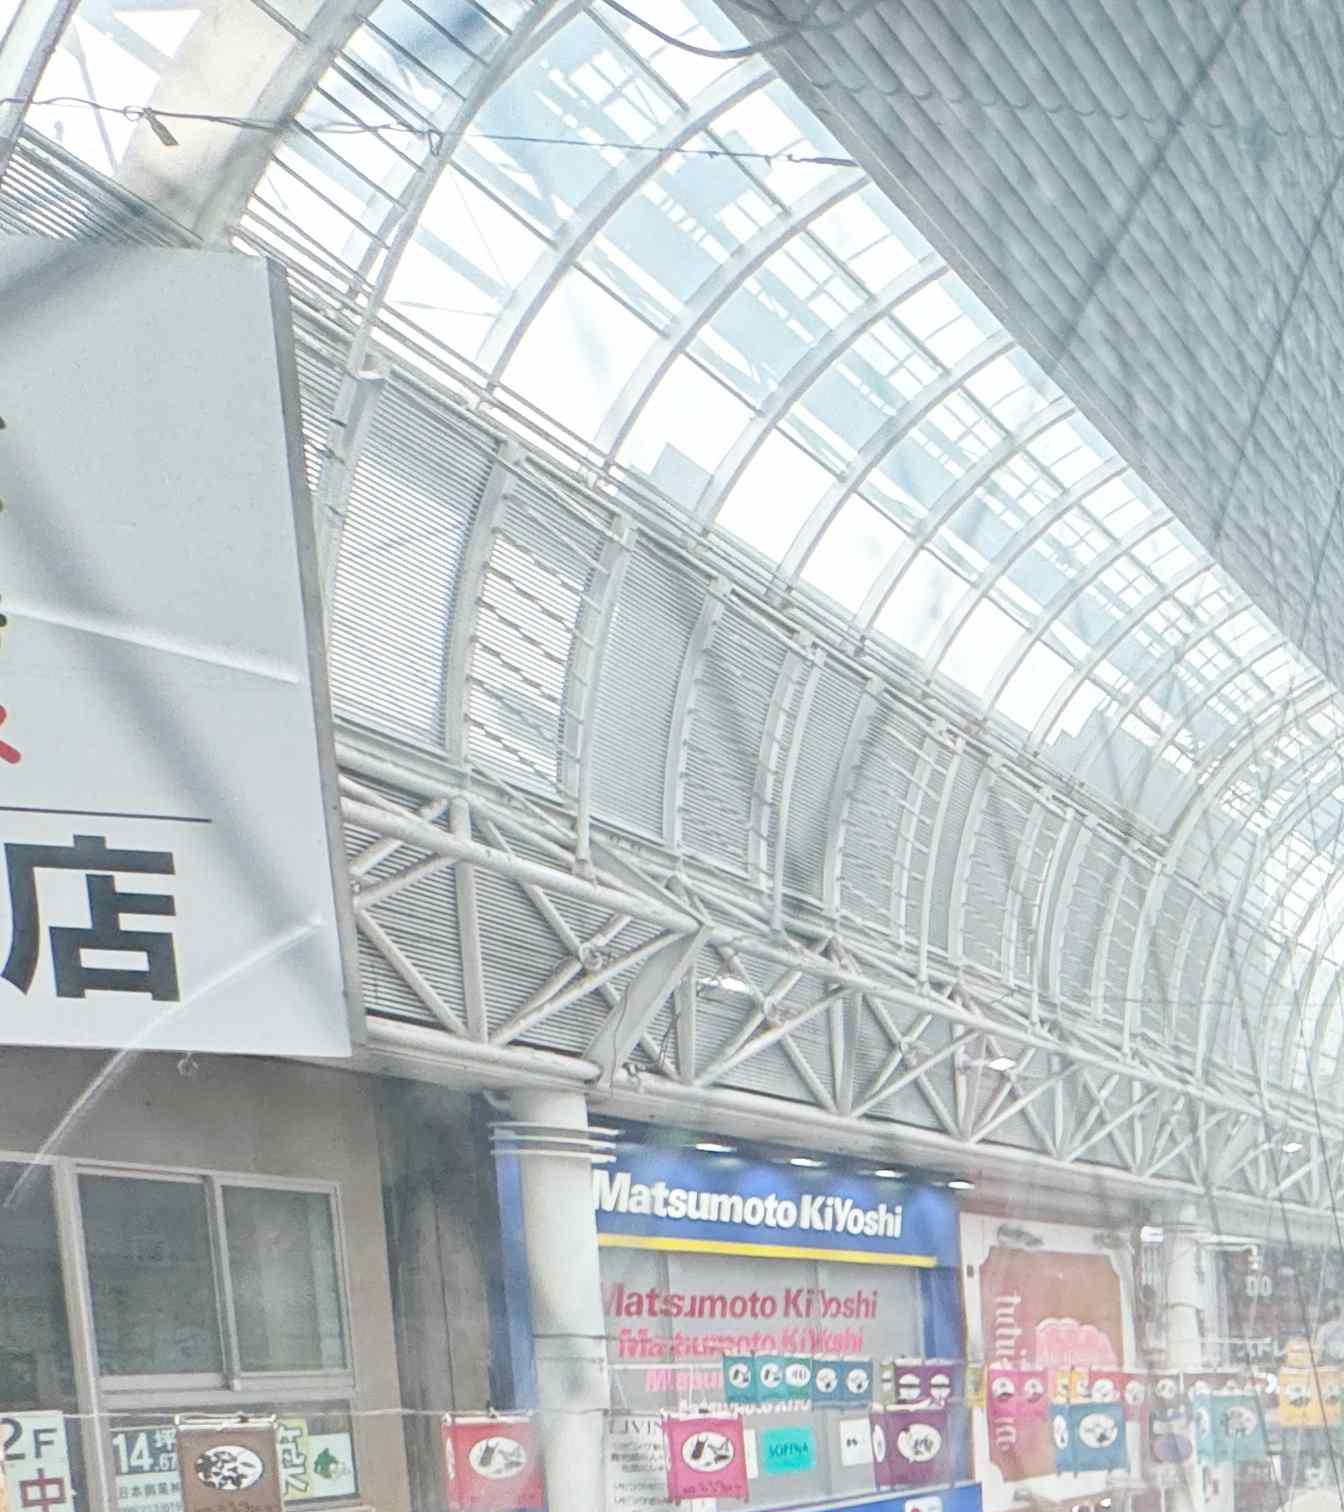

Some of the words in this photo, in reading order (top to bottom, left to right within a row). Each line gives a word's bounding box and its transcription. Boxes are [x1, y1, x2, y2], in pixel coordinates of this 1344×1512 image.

[1, 833, 181, 1002] 店
[591, 1169, 797, 1229] Matsumoto
[799, 1194, 902, 1238] KiYoshi
